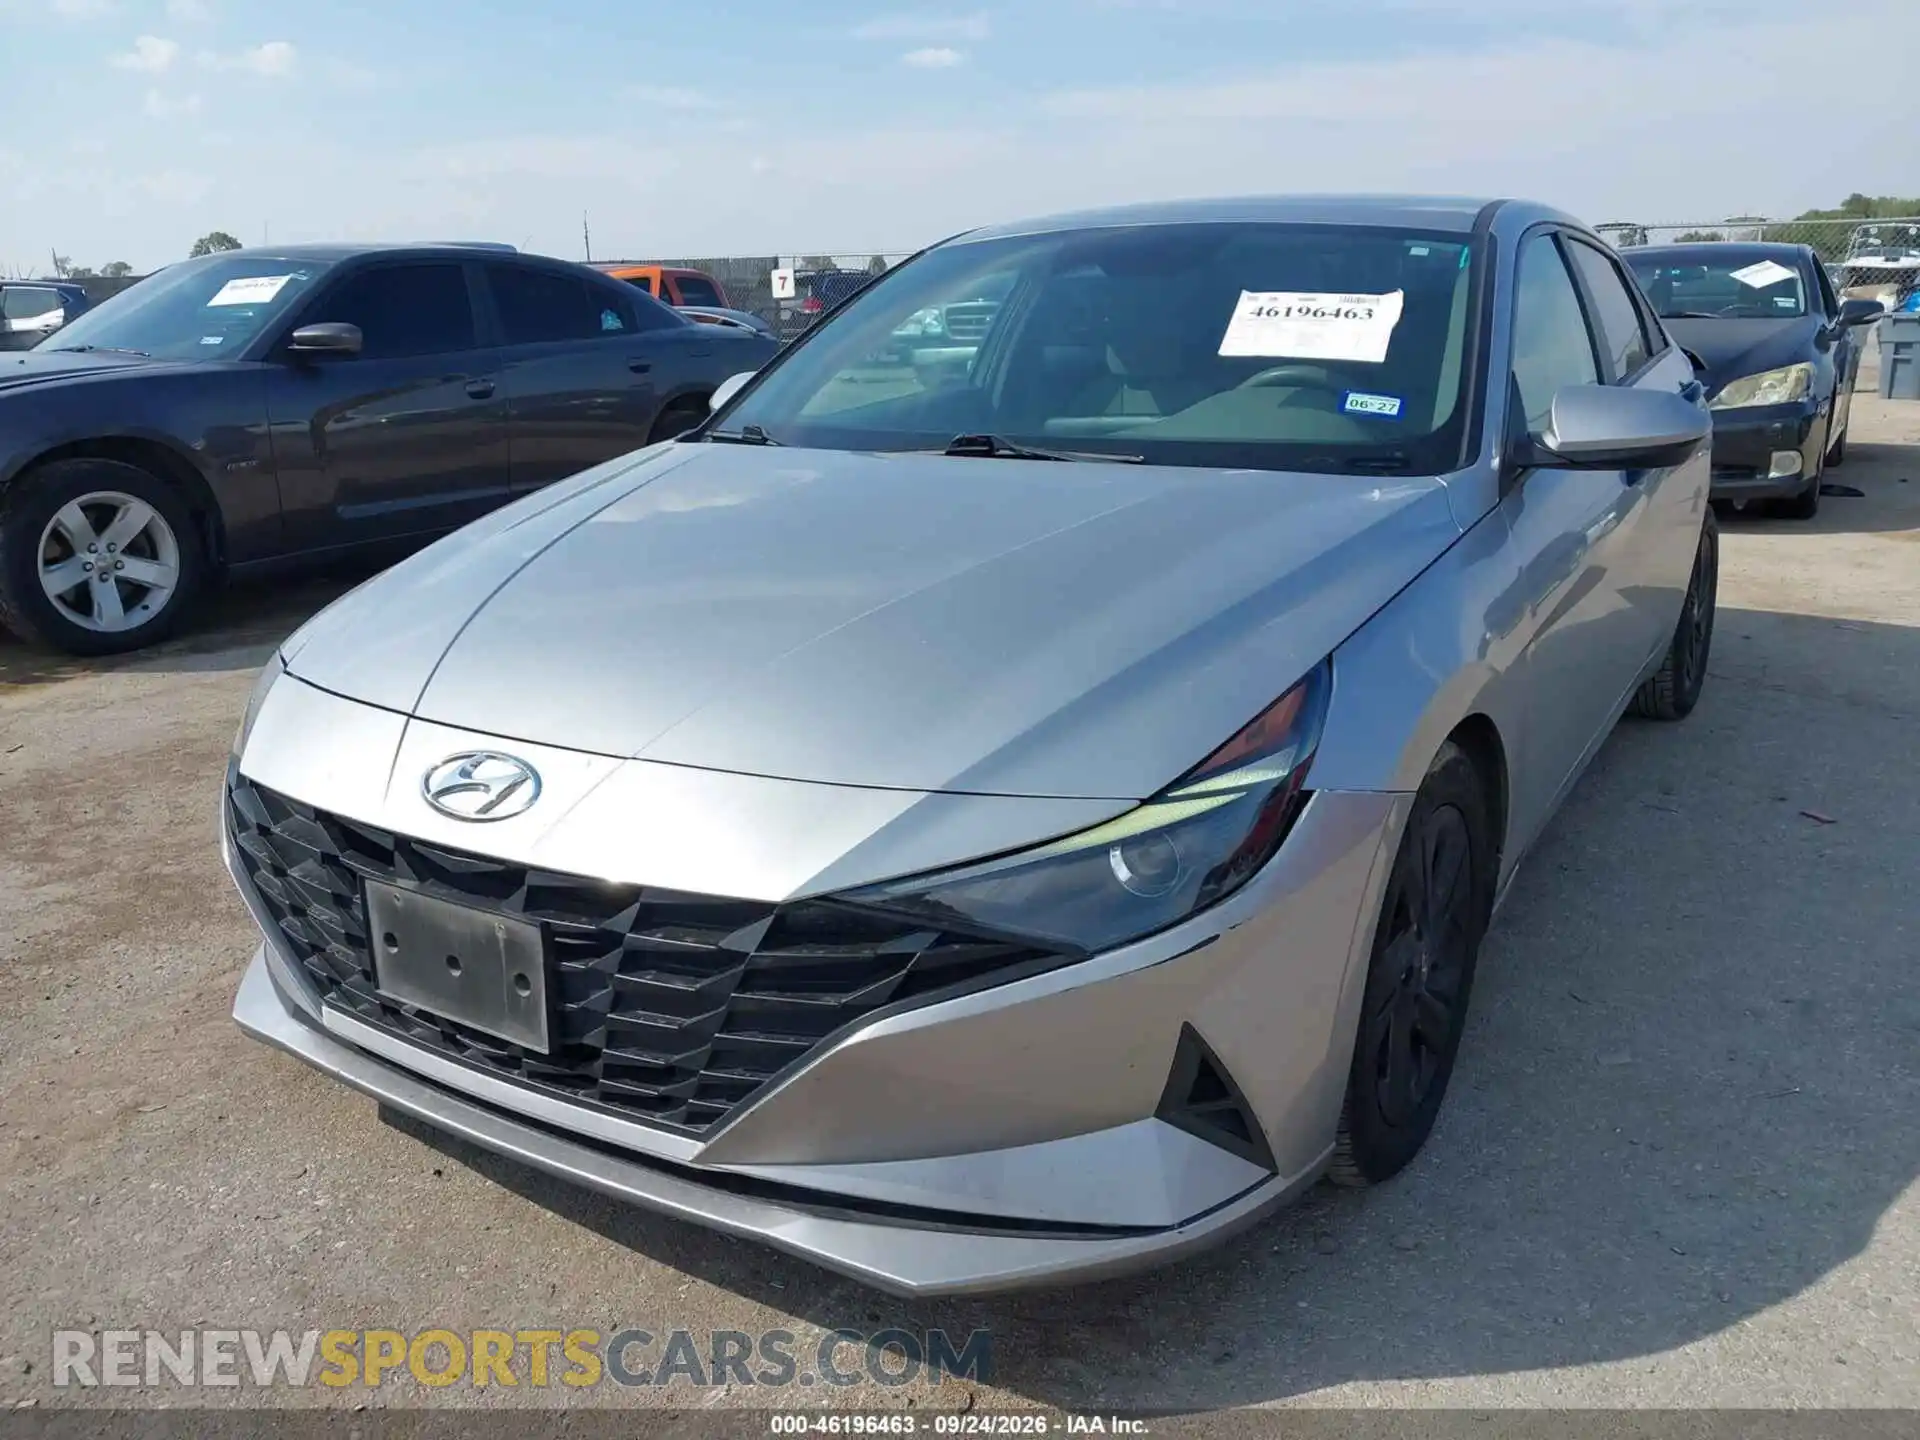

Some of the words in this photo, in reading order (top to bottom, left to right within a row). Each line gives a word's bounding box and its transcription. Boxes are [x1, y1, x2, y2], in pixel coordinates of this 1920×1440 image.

[778, 276, 788, 291] 7
[1249, 305, 1375, 320] 46196463
[1350, 399, 1368, 409] 06
[1377, 402, 1397, 412] 27
